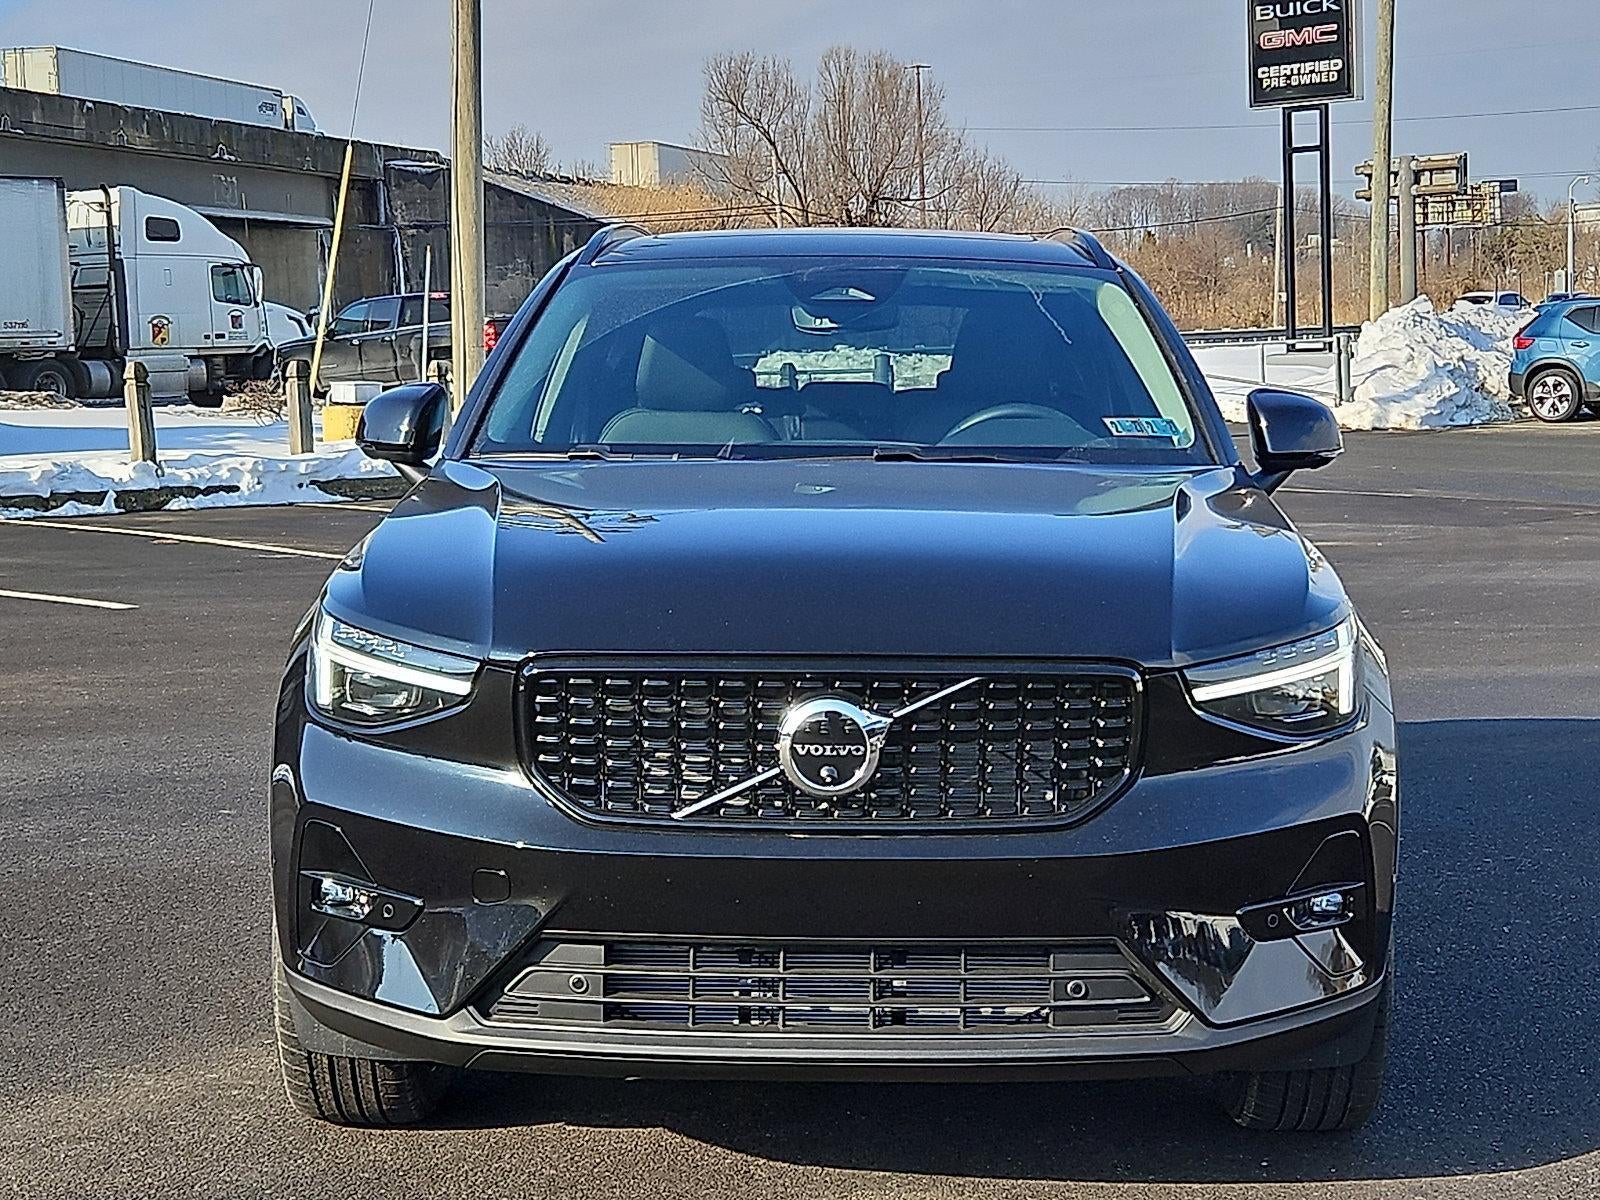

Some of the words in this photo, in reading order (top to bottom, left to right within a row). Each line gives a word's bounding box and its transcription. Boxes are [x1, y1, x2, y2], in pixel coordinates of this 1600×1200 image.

[1255, 0, 1341, 20] BUICK
[1260, 24, 1338, 49] GMC
[1257, 58, 1343, 78] CERTIFIED
[1262, 71, 1338, 89] PRE-OWNED
[793, 744, 865, 756] VOLVO
